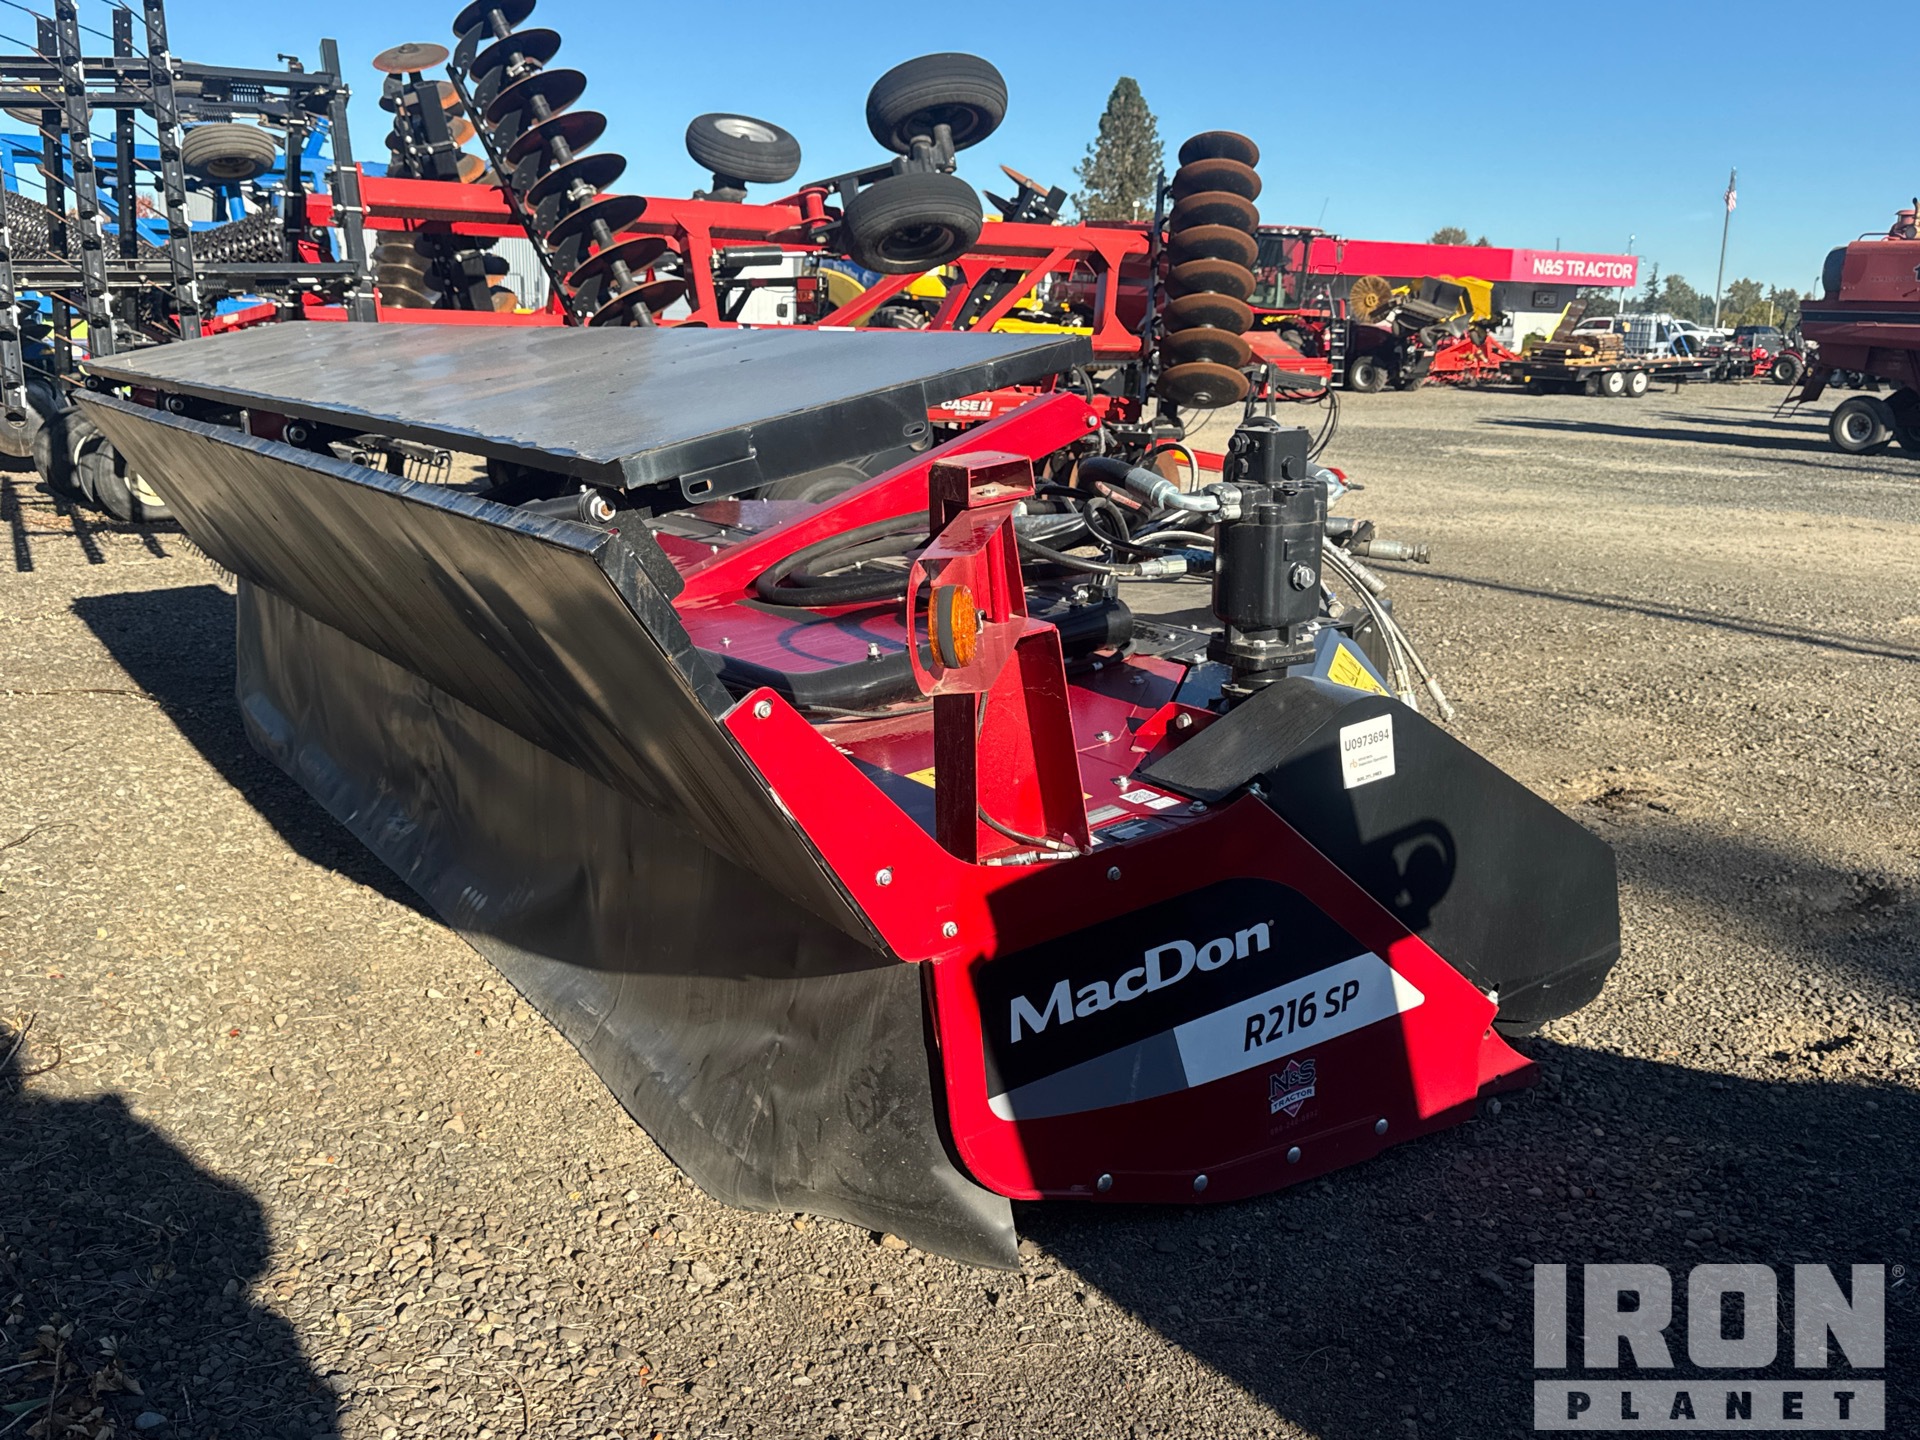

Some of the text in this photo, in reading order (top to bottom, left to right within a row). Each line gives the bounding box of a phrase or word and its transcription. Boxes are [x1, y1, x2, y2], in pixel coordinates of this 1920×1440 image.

[1533, 258, 1633, 279] N&S TRACTOR
[940, 399, 980, 411] CASE
[1345, 729, 1388, 751] U0973694
[1010, 921, 1272, 1044] MacDon
[1244, 979, 1360, 1053] R216 SP
[1269, 1058, 1316, 1100] N&S
[1273, 1088, 1313, 1110] TRACTOR
